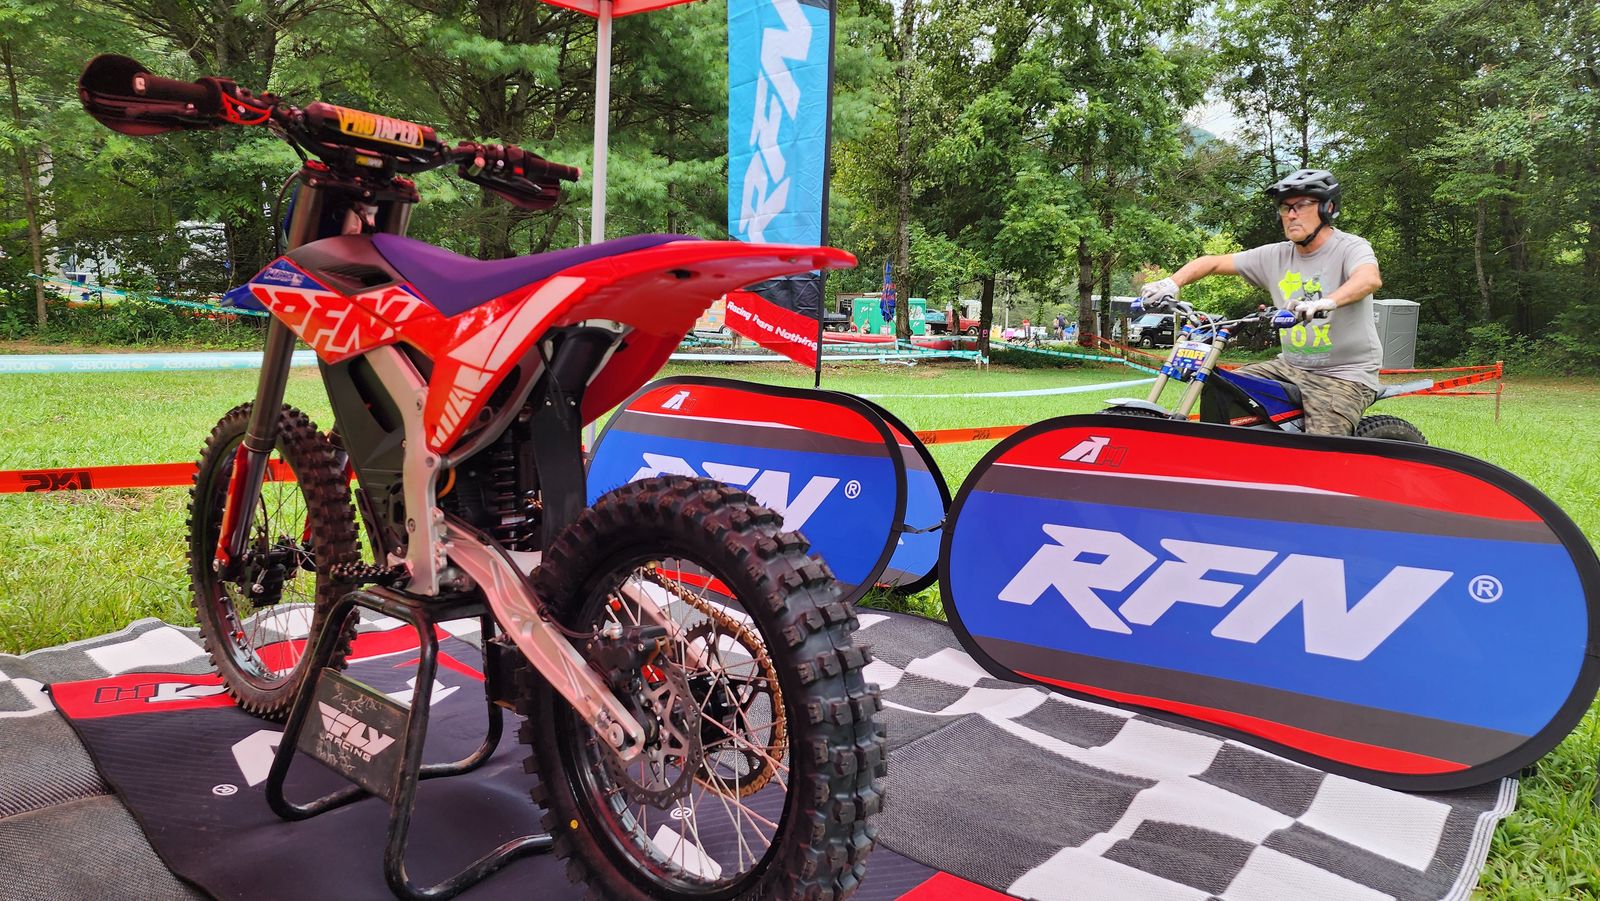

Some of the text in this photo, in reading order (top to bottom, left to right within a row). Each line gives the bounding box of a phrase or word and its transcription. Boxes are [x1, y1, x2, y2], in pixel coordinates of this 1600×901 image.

[738, 0, 813, 243] RFN
[727, 301, 752, 320] Racing
[775, 326, 818, 351] Nothing
[1177, 349, 1206, 361] STAFF
[998, 523, 1454, 661] RFN
[318, 701, 396, 756] FLY
[325, 732, 372, 762] RACING
